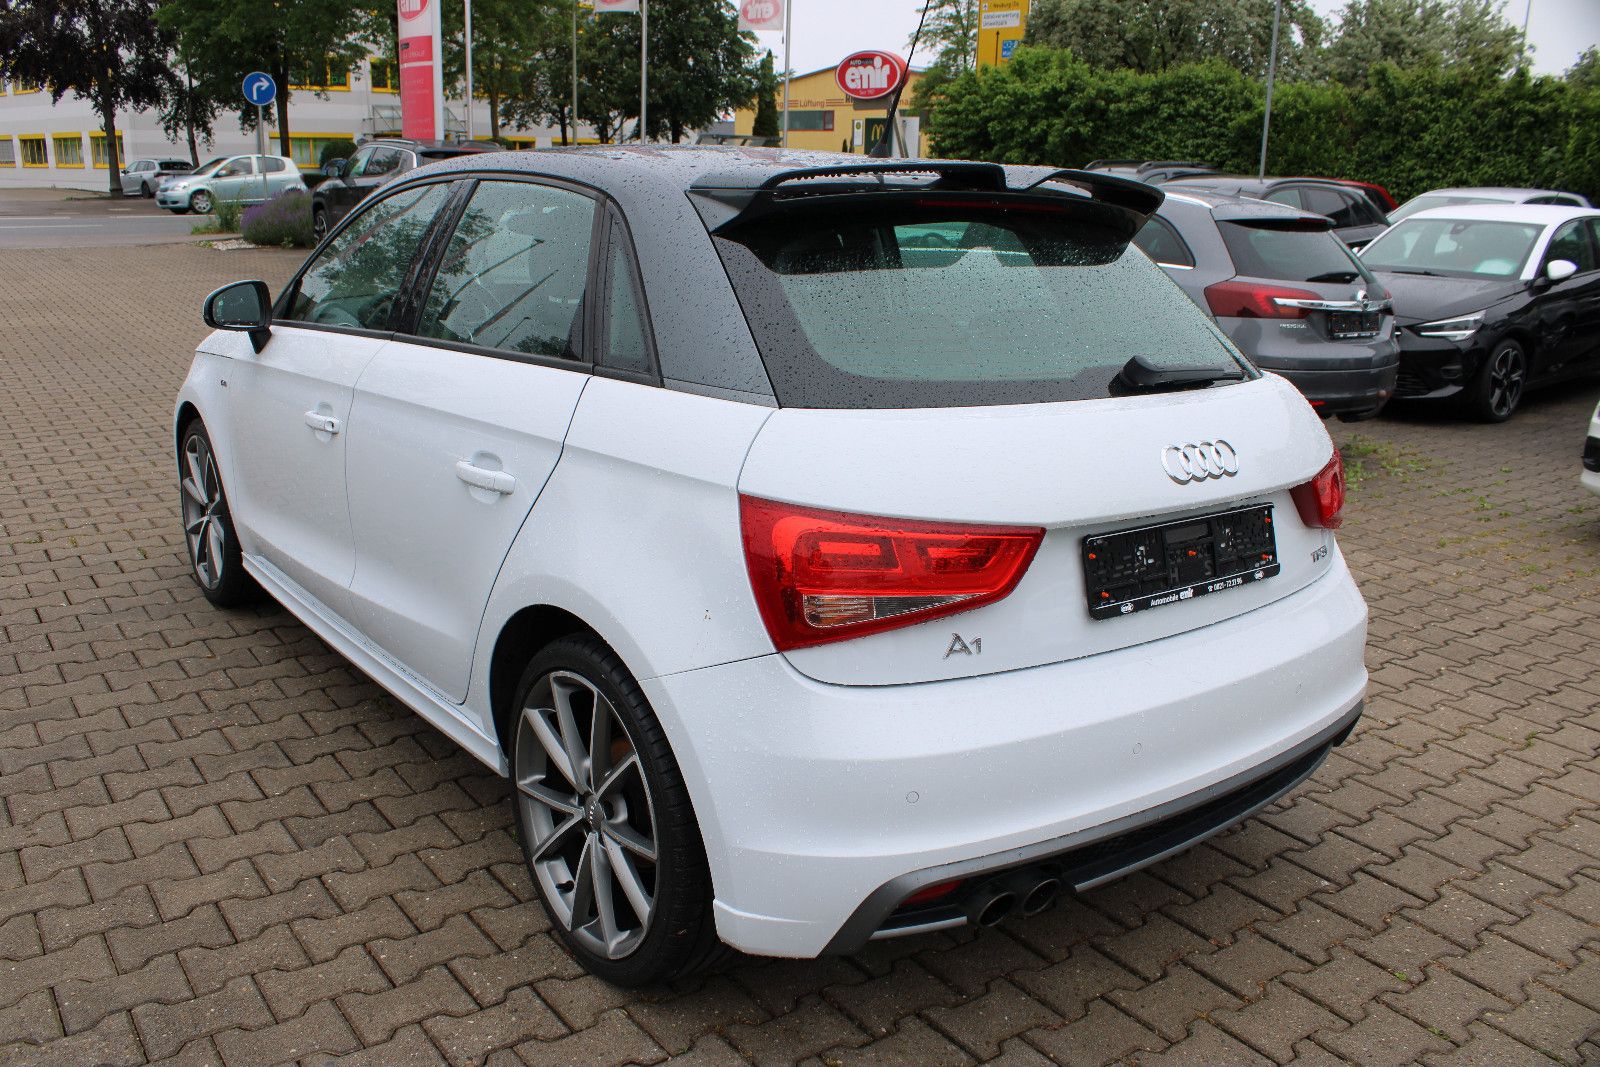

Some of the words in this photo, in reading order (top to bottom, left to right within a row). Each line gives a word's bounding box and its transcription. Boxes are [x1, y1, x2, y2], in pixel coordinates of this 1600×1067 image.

[845, 56, 890, 89] emir
[1150, 593, 1179, 607] Automobile
[1179, 587, 1194, 600] emir
[942, 632, 982, 660] A1
